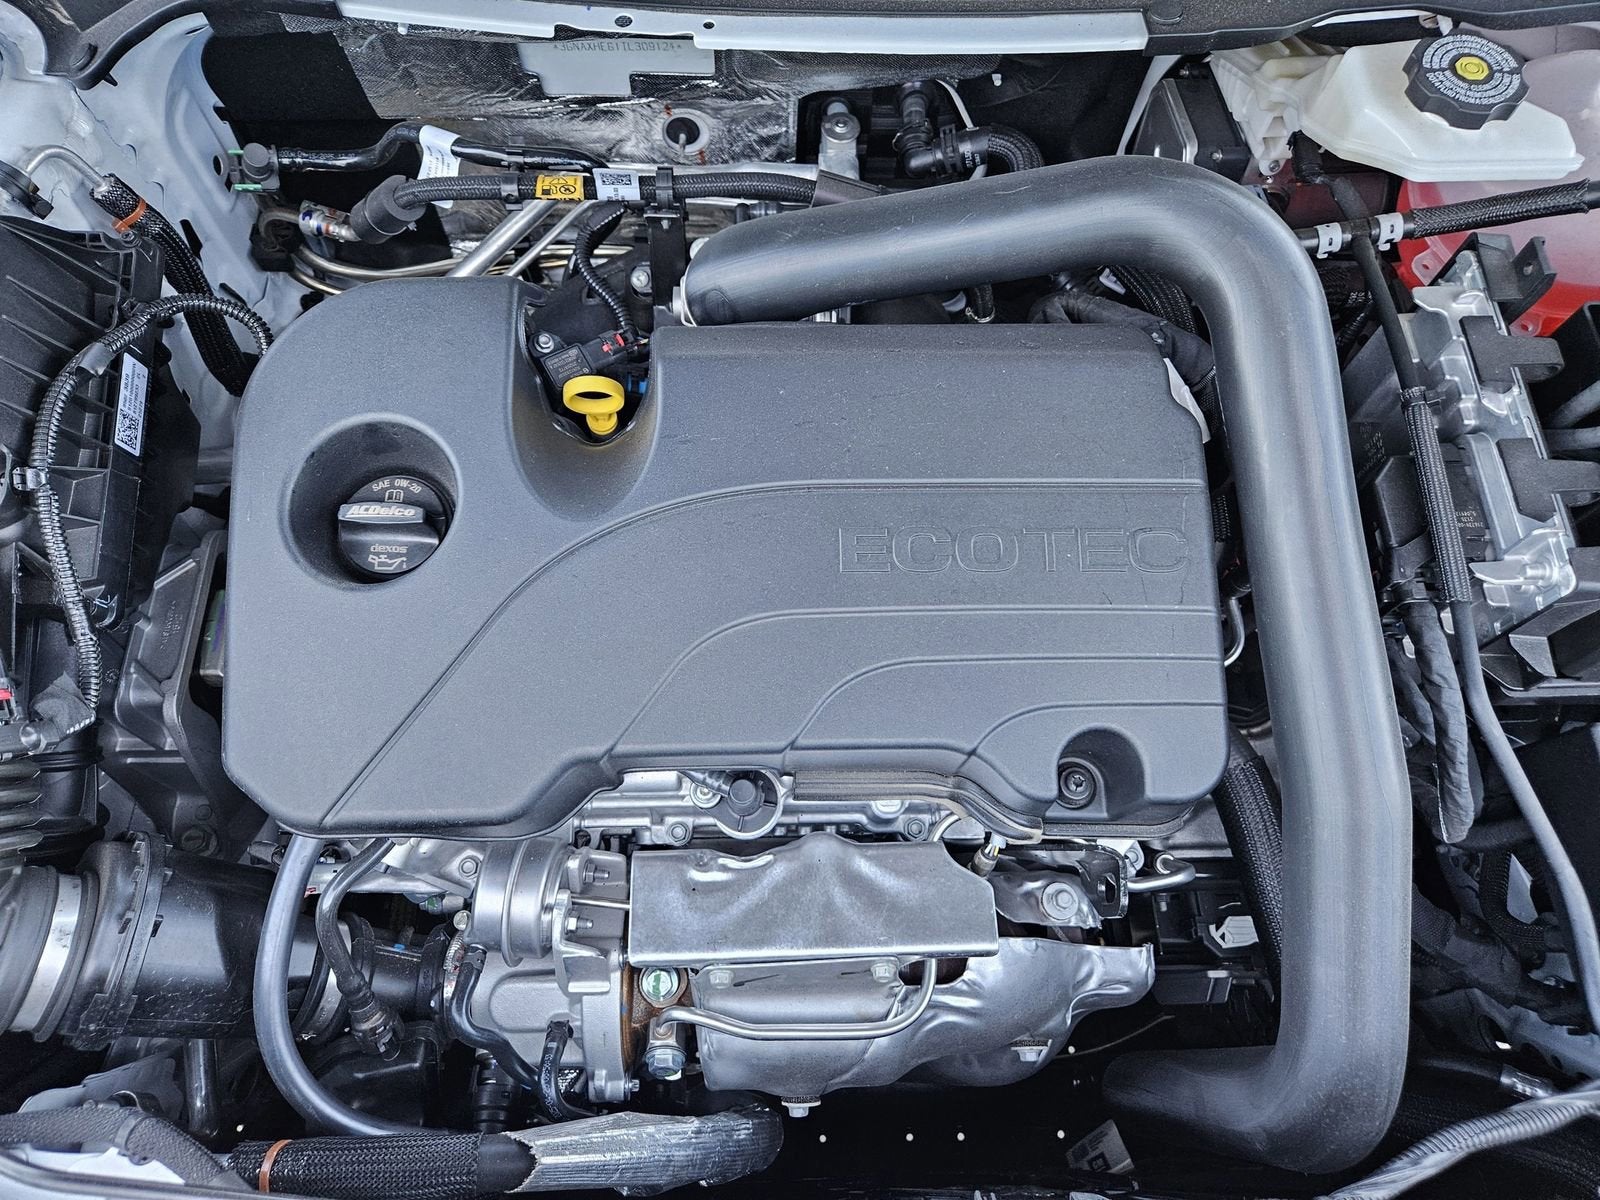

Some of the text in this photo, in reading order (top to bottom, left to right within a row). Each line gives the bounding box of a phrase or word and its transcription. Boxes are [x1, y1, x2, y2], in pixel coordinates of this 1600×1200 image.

[372, 479, 422, 494] SAE 0W-20
[346, 505, 416, 516] ACDelco
[370, 543, 408, 553] dexos
[839, 525, 1188, 573] ECOTEC
